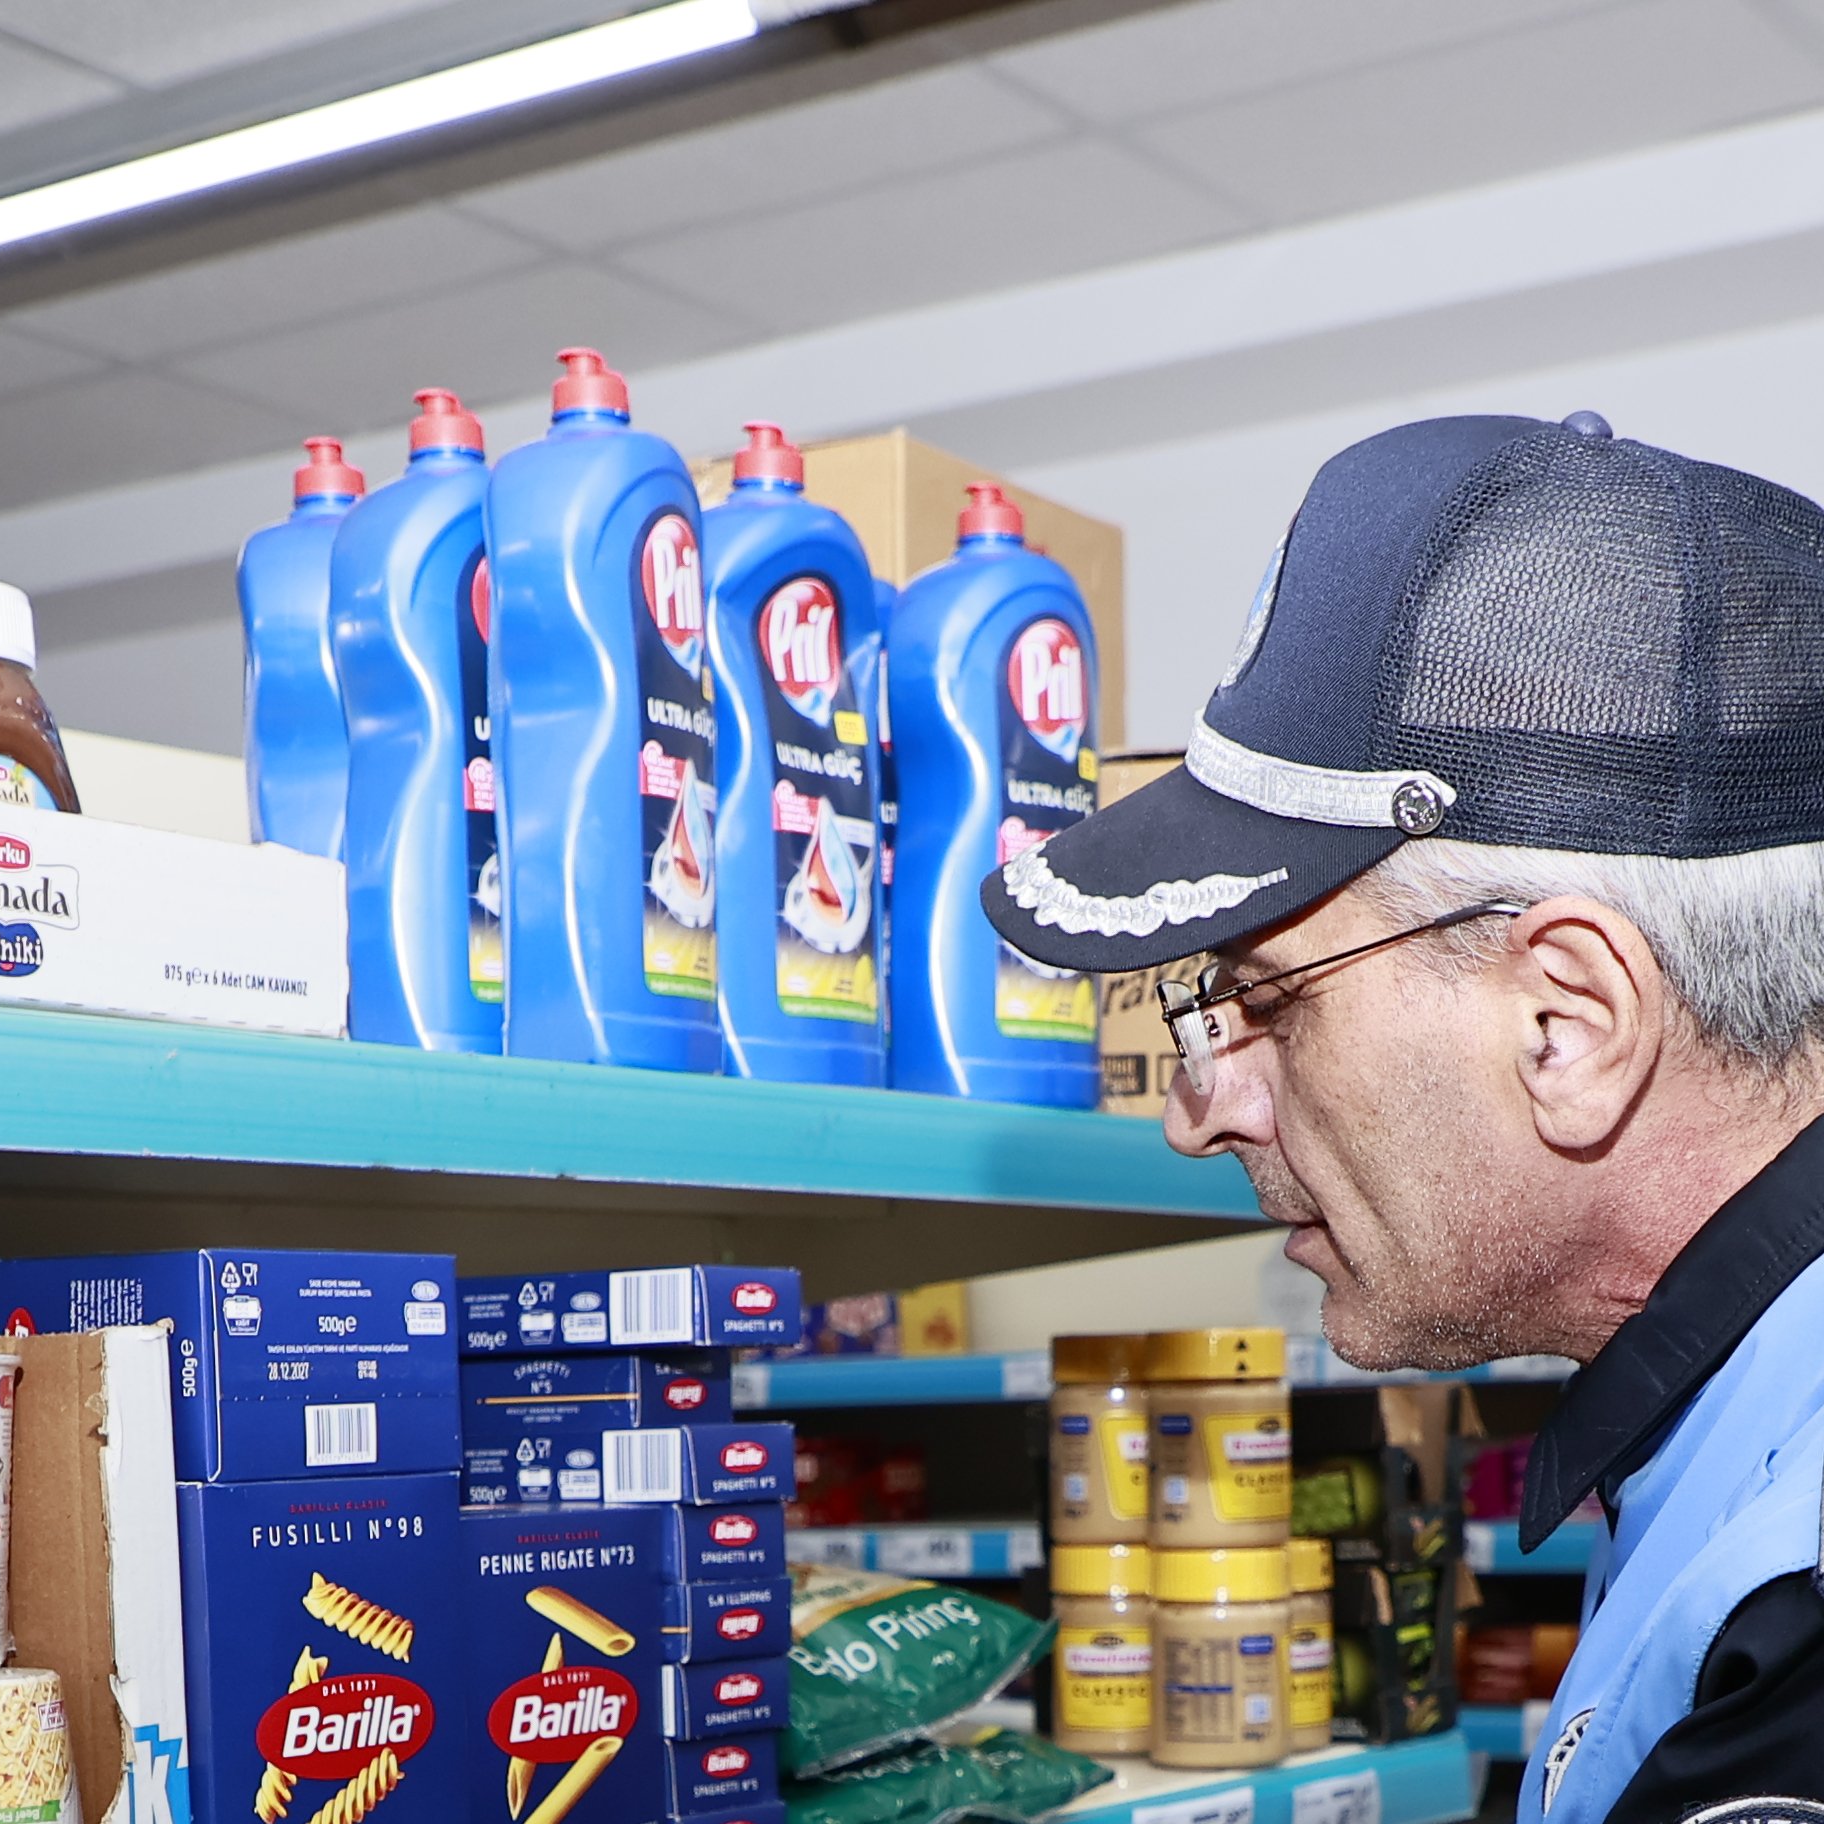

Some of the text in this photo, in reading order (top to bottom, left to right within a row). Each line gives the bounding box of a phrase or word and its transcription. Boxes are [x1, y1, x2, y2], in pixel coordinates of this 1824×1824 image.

[651, 534, 703, 630] Pril
[768, 589, 835, 683] Pril
[1020, 641, 1084, 722] Pril
[646, 696, 693, 735] ULTRA
[776, 742, 864, 787] ULTRA GÜÇ
[164, 965, 182, 982] 875
[220, 972, 243, 990] Adet
[244, 975, 266, 992] CAM
[267, 978, 308, 997] KAVANOZ
[723, 1319, 761, 1333] SPAGHETTI
[252, 1520, 353, 1549] FUSILLI
[479, 1552, 535, 1577] PENNE
[540, 1547, 595, 1572] RIGATE
[866, 1596, 982, 1653] Pirinç
[322, 1683, 346, 1697] DAL
[282, 1694, 414, 1760] Barilla
[509, 1685, 622, 1745] Barilla
